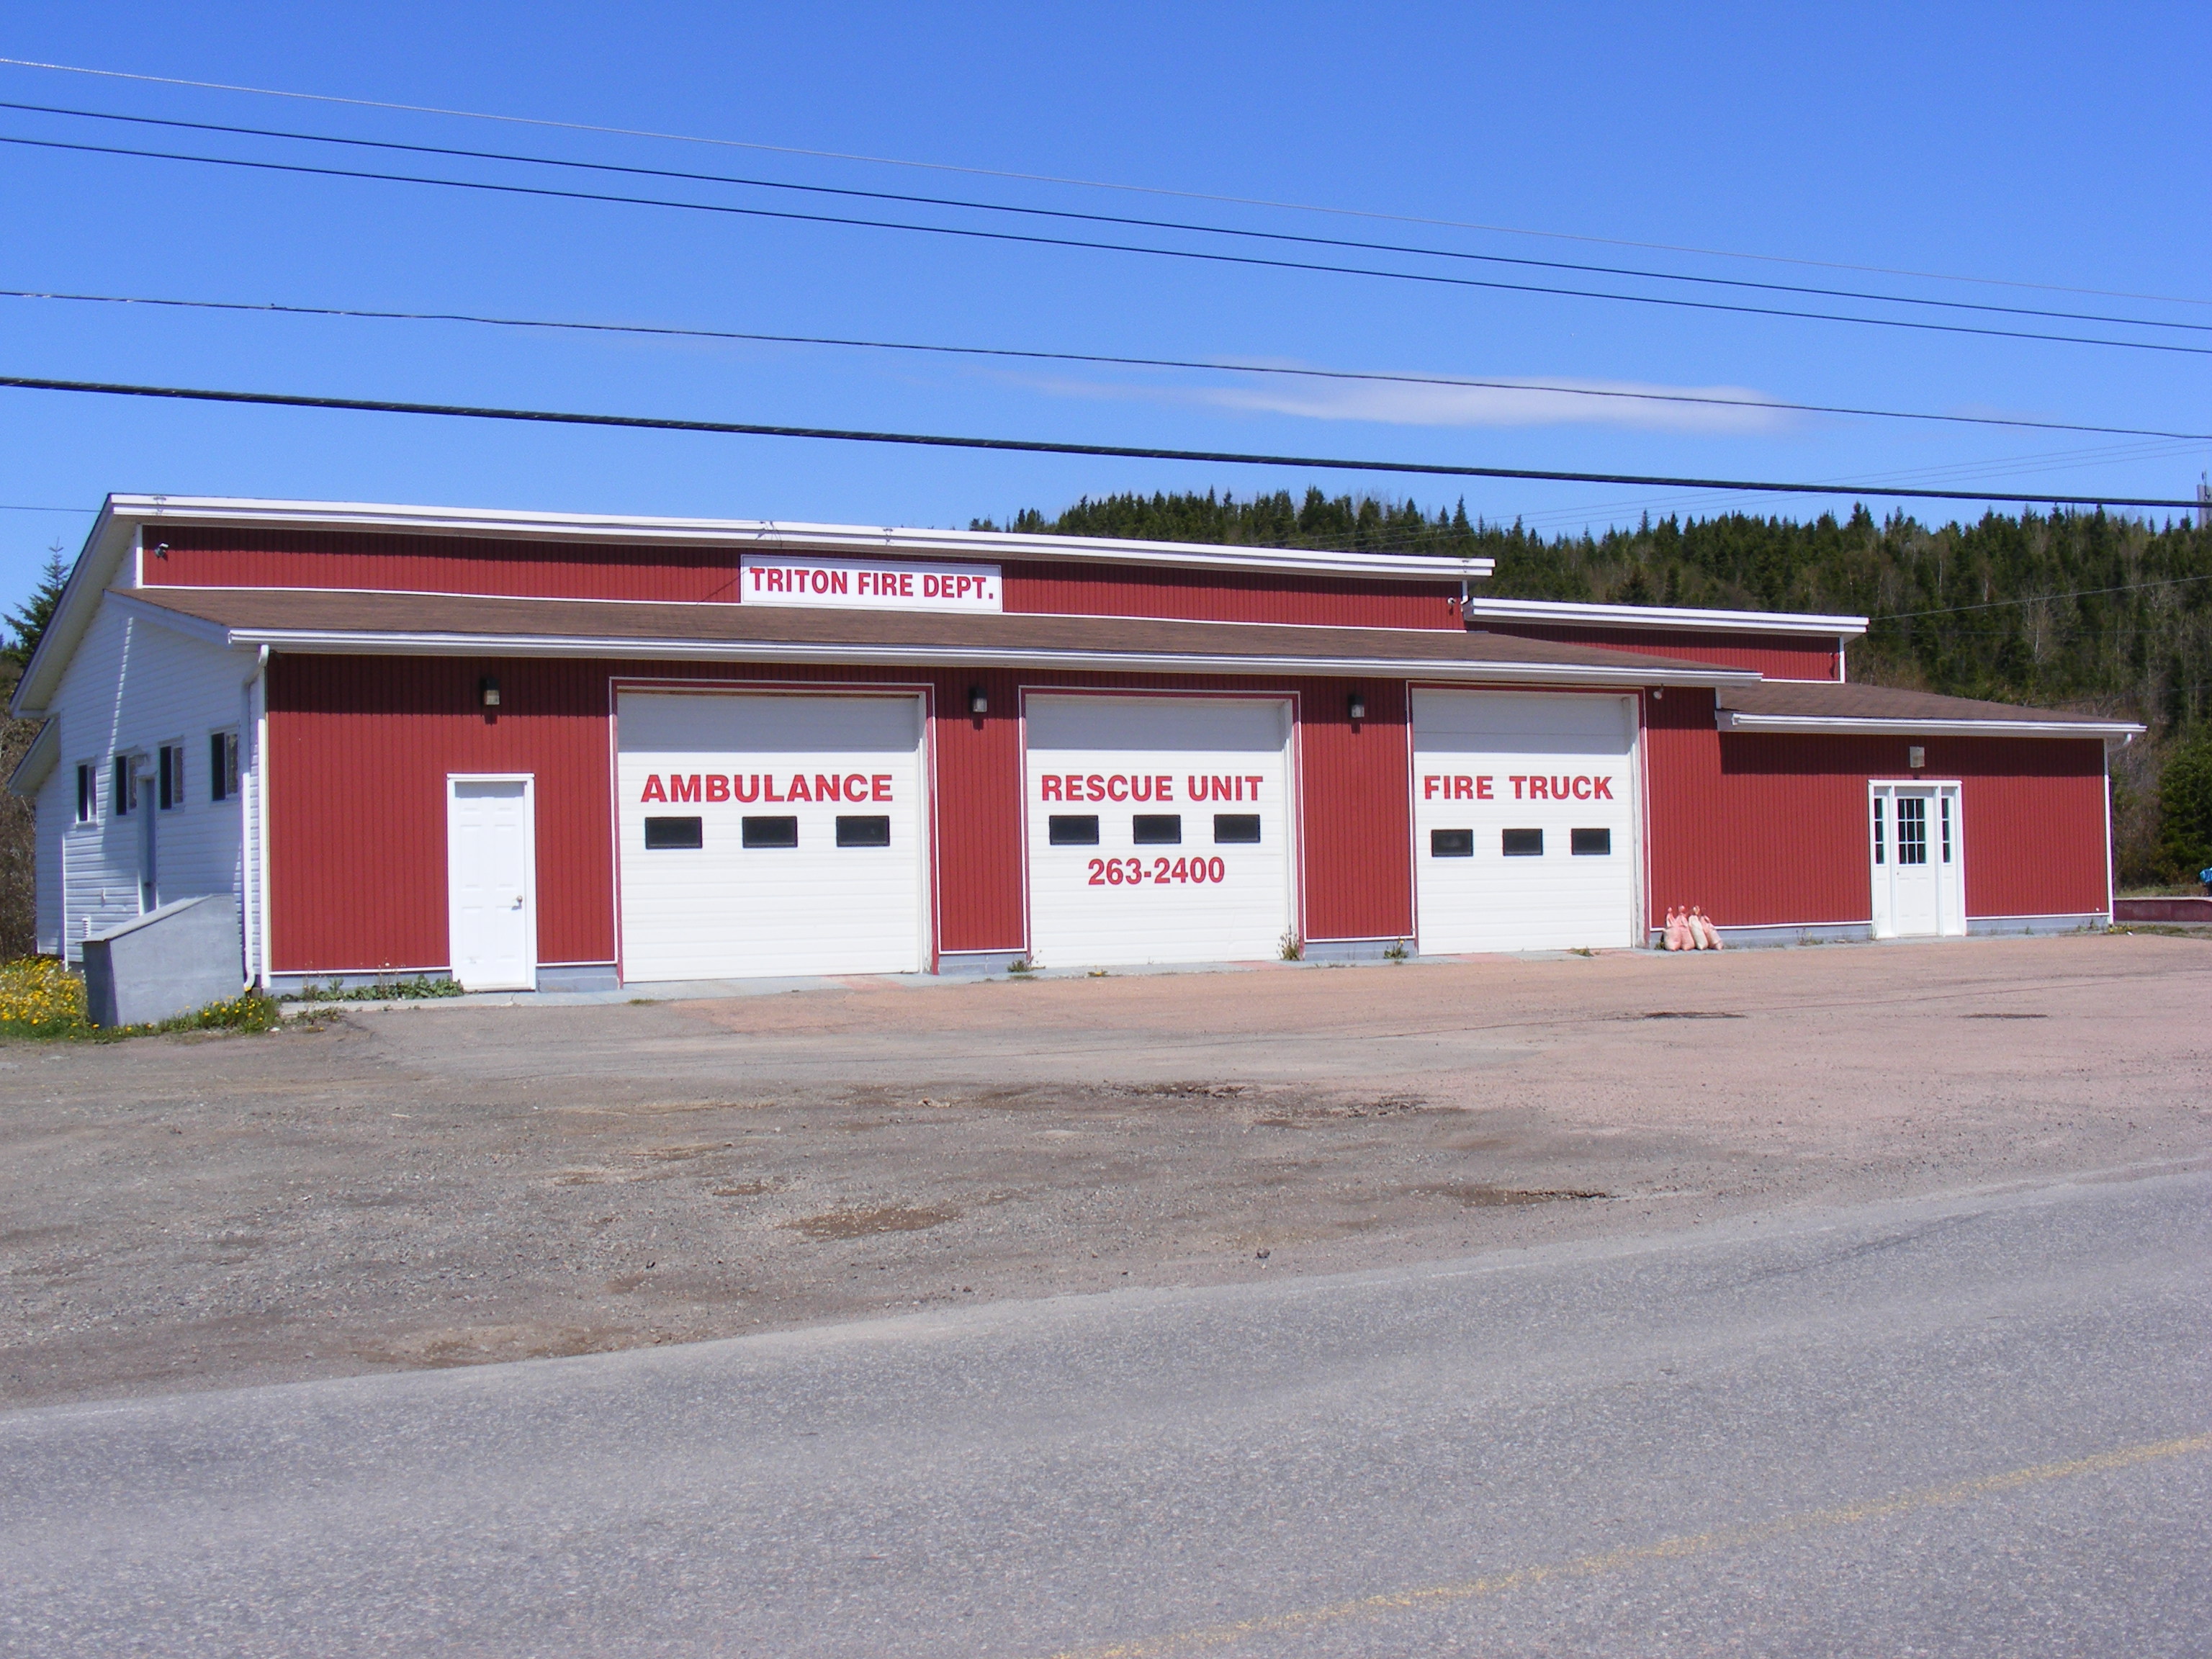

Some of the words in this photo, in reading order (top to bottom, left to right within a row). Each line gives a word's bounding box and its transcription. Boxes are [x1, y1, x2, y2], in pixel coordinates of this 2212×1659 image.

[749, 567, 848, 594] TRITON
[858, 572, 913, 597] FIRE
[923, 575, 994, 599] DEPT.
[641, 774, 893, 804] AMBULANCE
[1041, 775, 1173, 802] RESCUE
[1187, 775, 1263, 801] UNIT
[1424, 775, 1493, 800] FIRE
[1509, 775, 1614, 800] TRUCK
[1088, 857, 1225, 886] 263-2400
